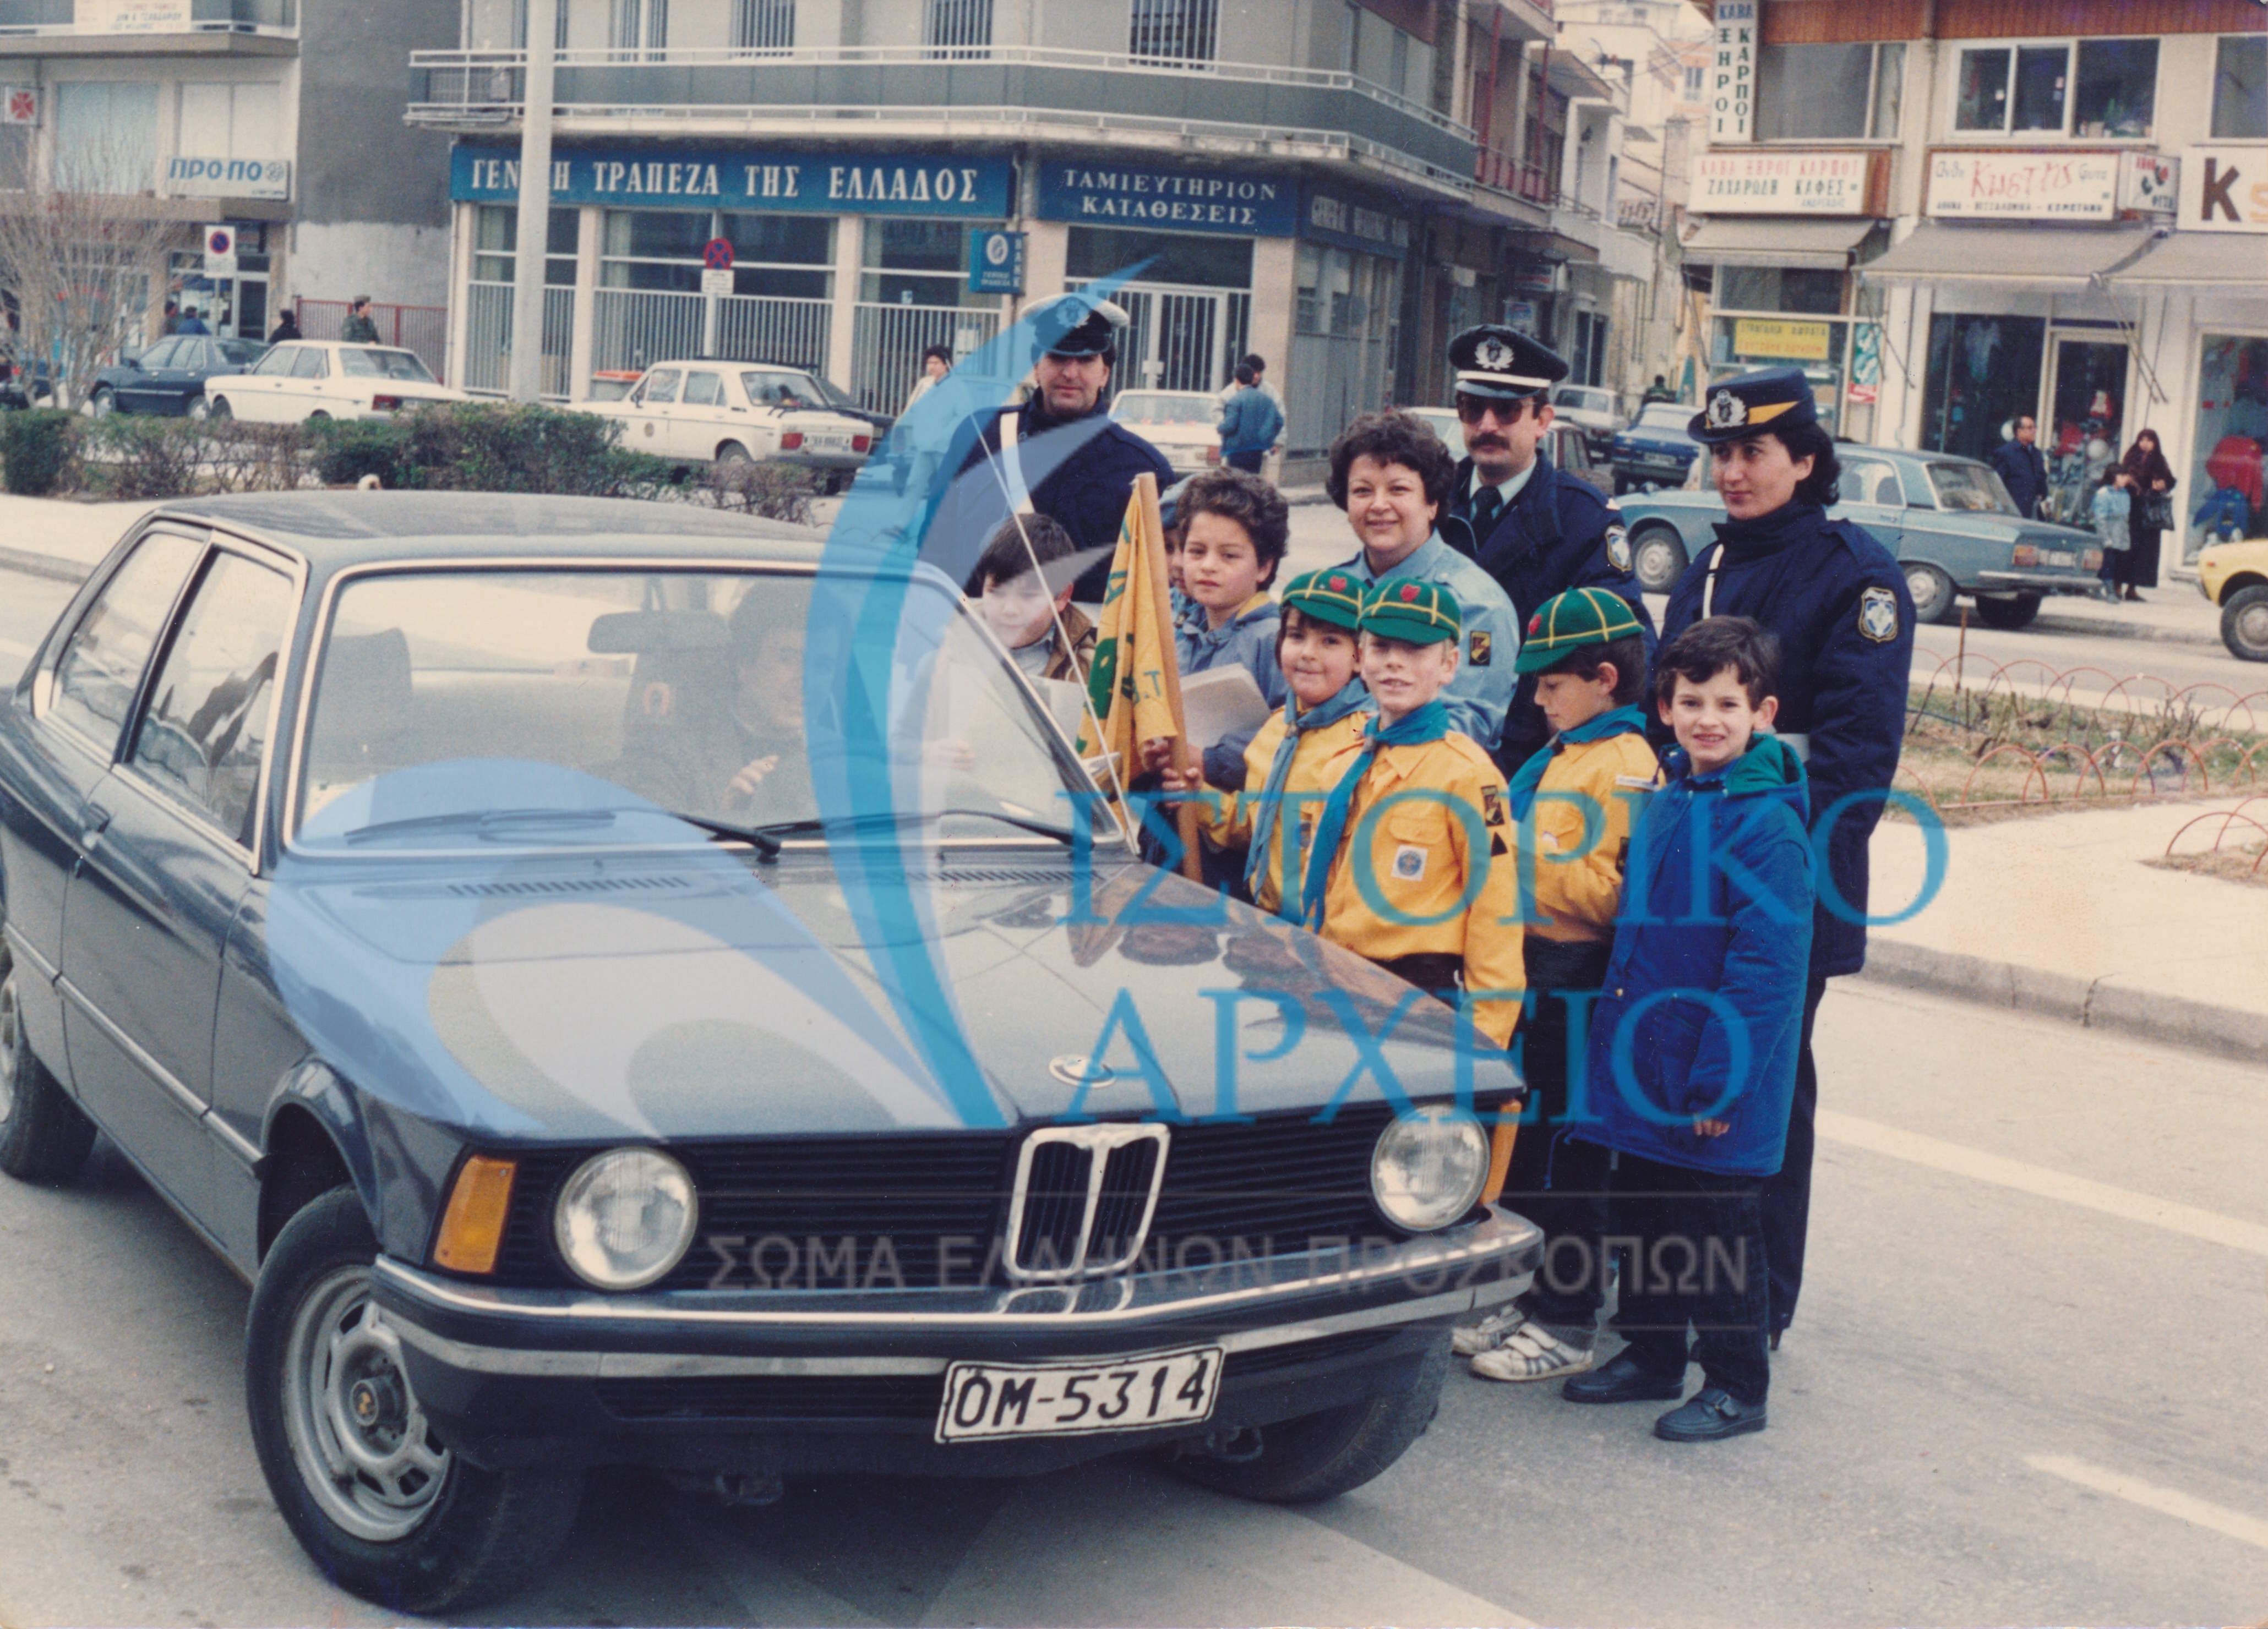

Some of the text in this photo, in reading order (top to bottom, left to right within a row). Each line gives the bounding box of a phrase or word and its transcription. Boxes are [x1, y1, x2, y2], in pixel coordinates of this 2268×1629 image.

[1719, 4, 1753, 20] ΚΑΒΑ
[1715, 28, 1731, 133] ΞΗΡΟΙ
[1735, 28, 1751, 134] ΚΑΡΠΟΙ
[472, 158, 978, 202] ΓΕΝΗ ΤΡΑΠΕΖΑ ΤΗΣ ΕΛΛΑΔΟΣ
[1064, 169, 1277, 200] ΤΑΜΙΕΥΤΗΡΙΟΝ
[1082, 196, 1257, 225] ΚΑΤΑΘΕΣΕΙΣ
[954, 1358, 1209, 1426] OM-5314
